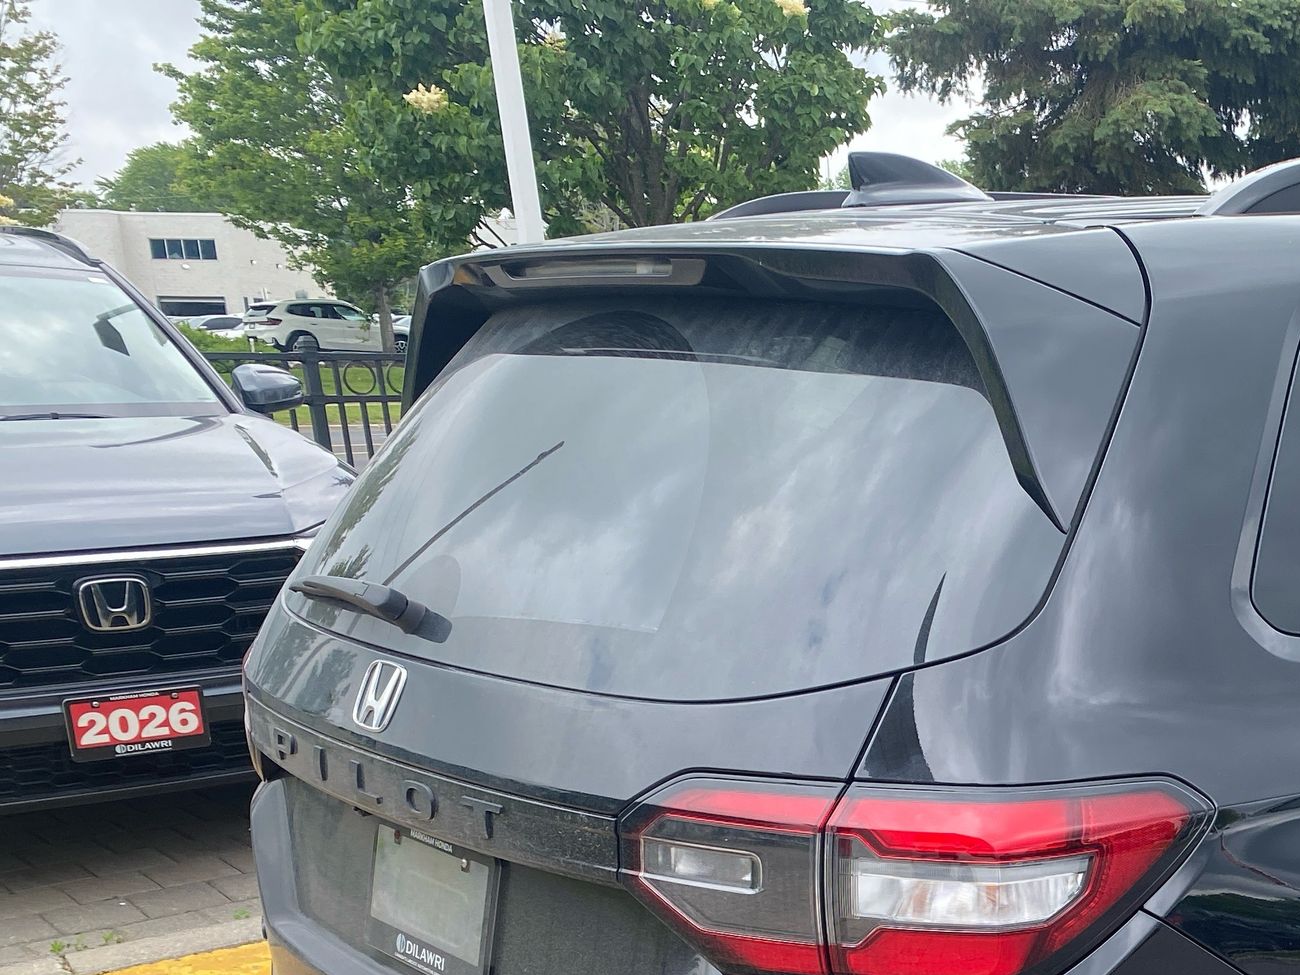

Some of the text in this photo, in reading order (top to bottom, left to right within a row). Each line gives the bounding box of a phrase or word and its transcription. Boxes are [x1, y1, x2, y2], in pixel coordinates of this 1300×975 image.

[77, 701, 199, 746] 2026
[126, 739, 172, 752] DILAWRI
[273, 726, 503, 840] PILOT
[405, 940, 445, 971] DILAWRI
